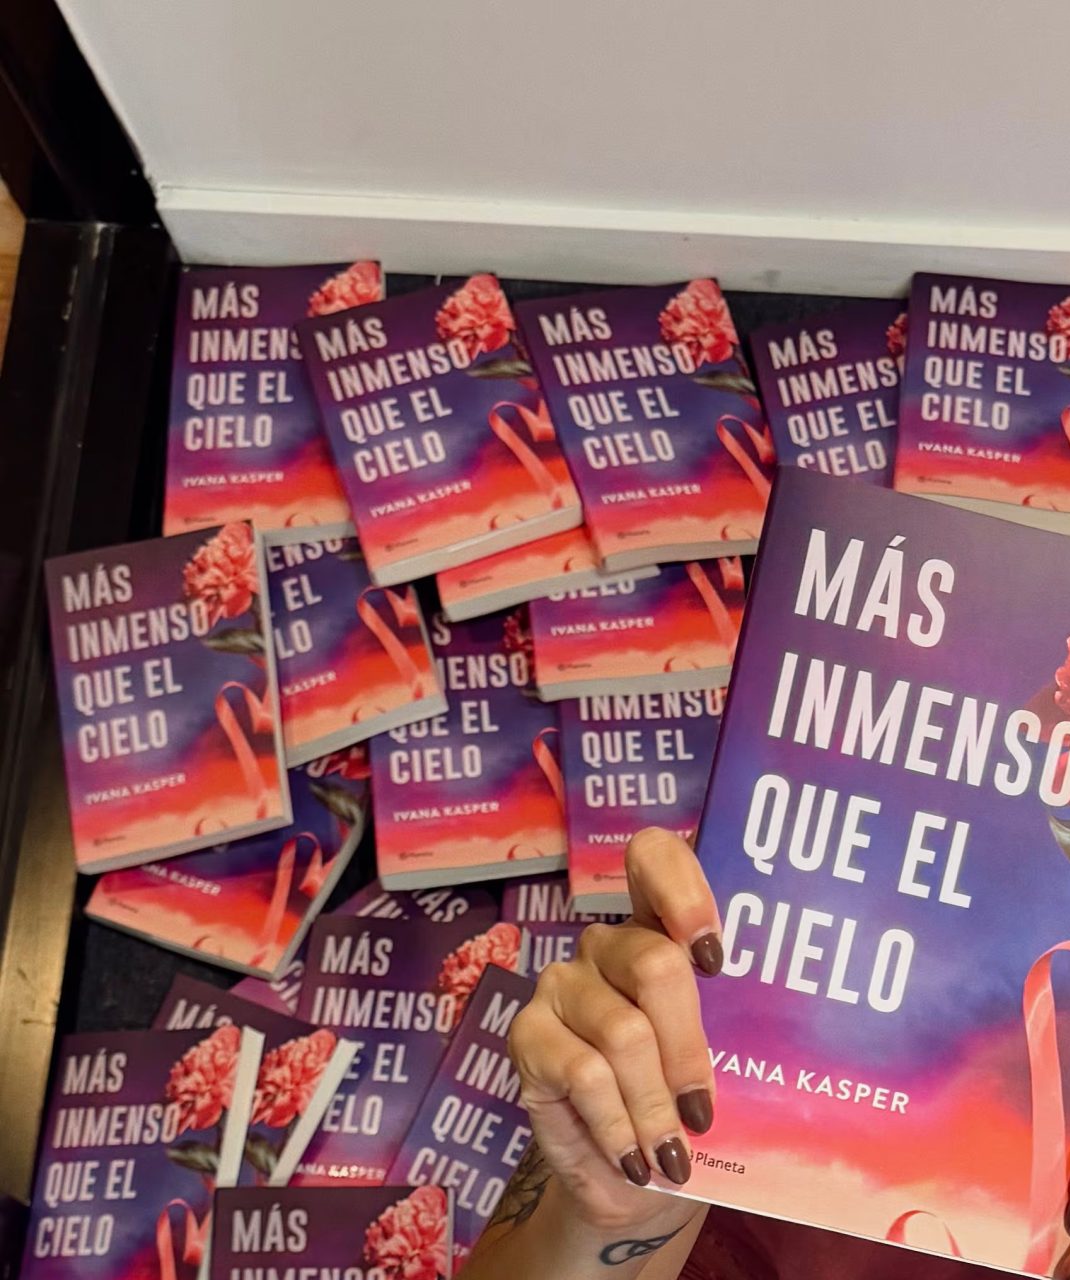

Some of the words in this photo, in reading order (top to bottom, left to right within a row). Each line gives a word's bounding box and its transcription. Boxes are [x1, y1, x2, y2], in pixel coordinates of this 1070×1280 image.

[539, 306, 611, 342] MÁS
[932, 285, 996, 317] MÁS
[316, 319, 386, 360] MÁS
[554, 341, 695, 384] INMENSO
[929, 320, 1067, 362] INMENSO
[329, 336, 470, 400] INMENSO
[926, 356, 982, 389] QUE
[995, 364, 1030, 395] EL
[341, 398, 405, 443] QUE
[410, 387, 452, 422] EL
[568, 391, 633, 430] QUE
[637, 387, 679, 420] EL
[923, 392, 1010, 430] CIELO
[354, 430, 446, 481] CIELO
[583, 430, 675, 468] CIELO
[64, 563, 131, 611] MÁS
[794, 528, 954, 648] MÁS
[69, 596, 209, 661] INMENSO
[74, 665, 134, 716] QUE
[144, 657, 182, 697] EL
[79, 709, 168, 762] CIELO
[742, 774, 881, 882] QUE
[899, 812, 973, 909] EL
[720, 892, 915, 1013] CIELO
[707, 1048, 785, 1086] VANA
[796, 1070, 910, 1114] KASPER
[694, 1152, 746, 1175] Planeta
[233, 1204, 306, 1252] MÁS
